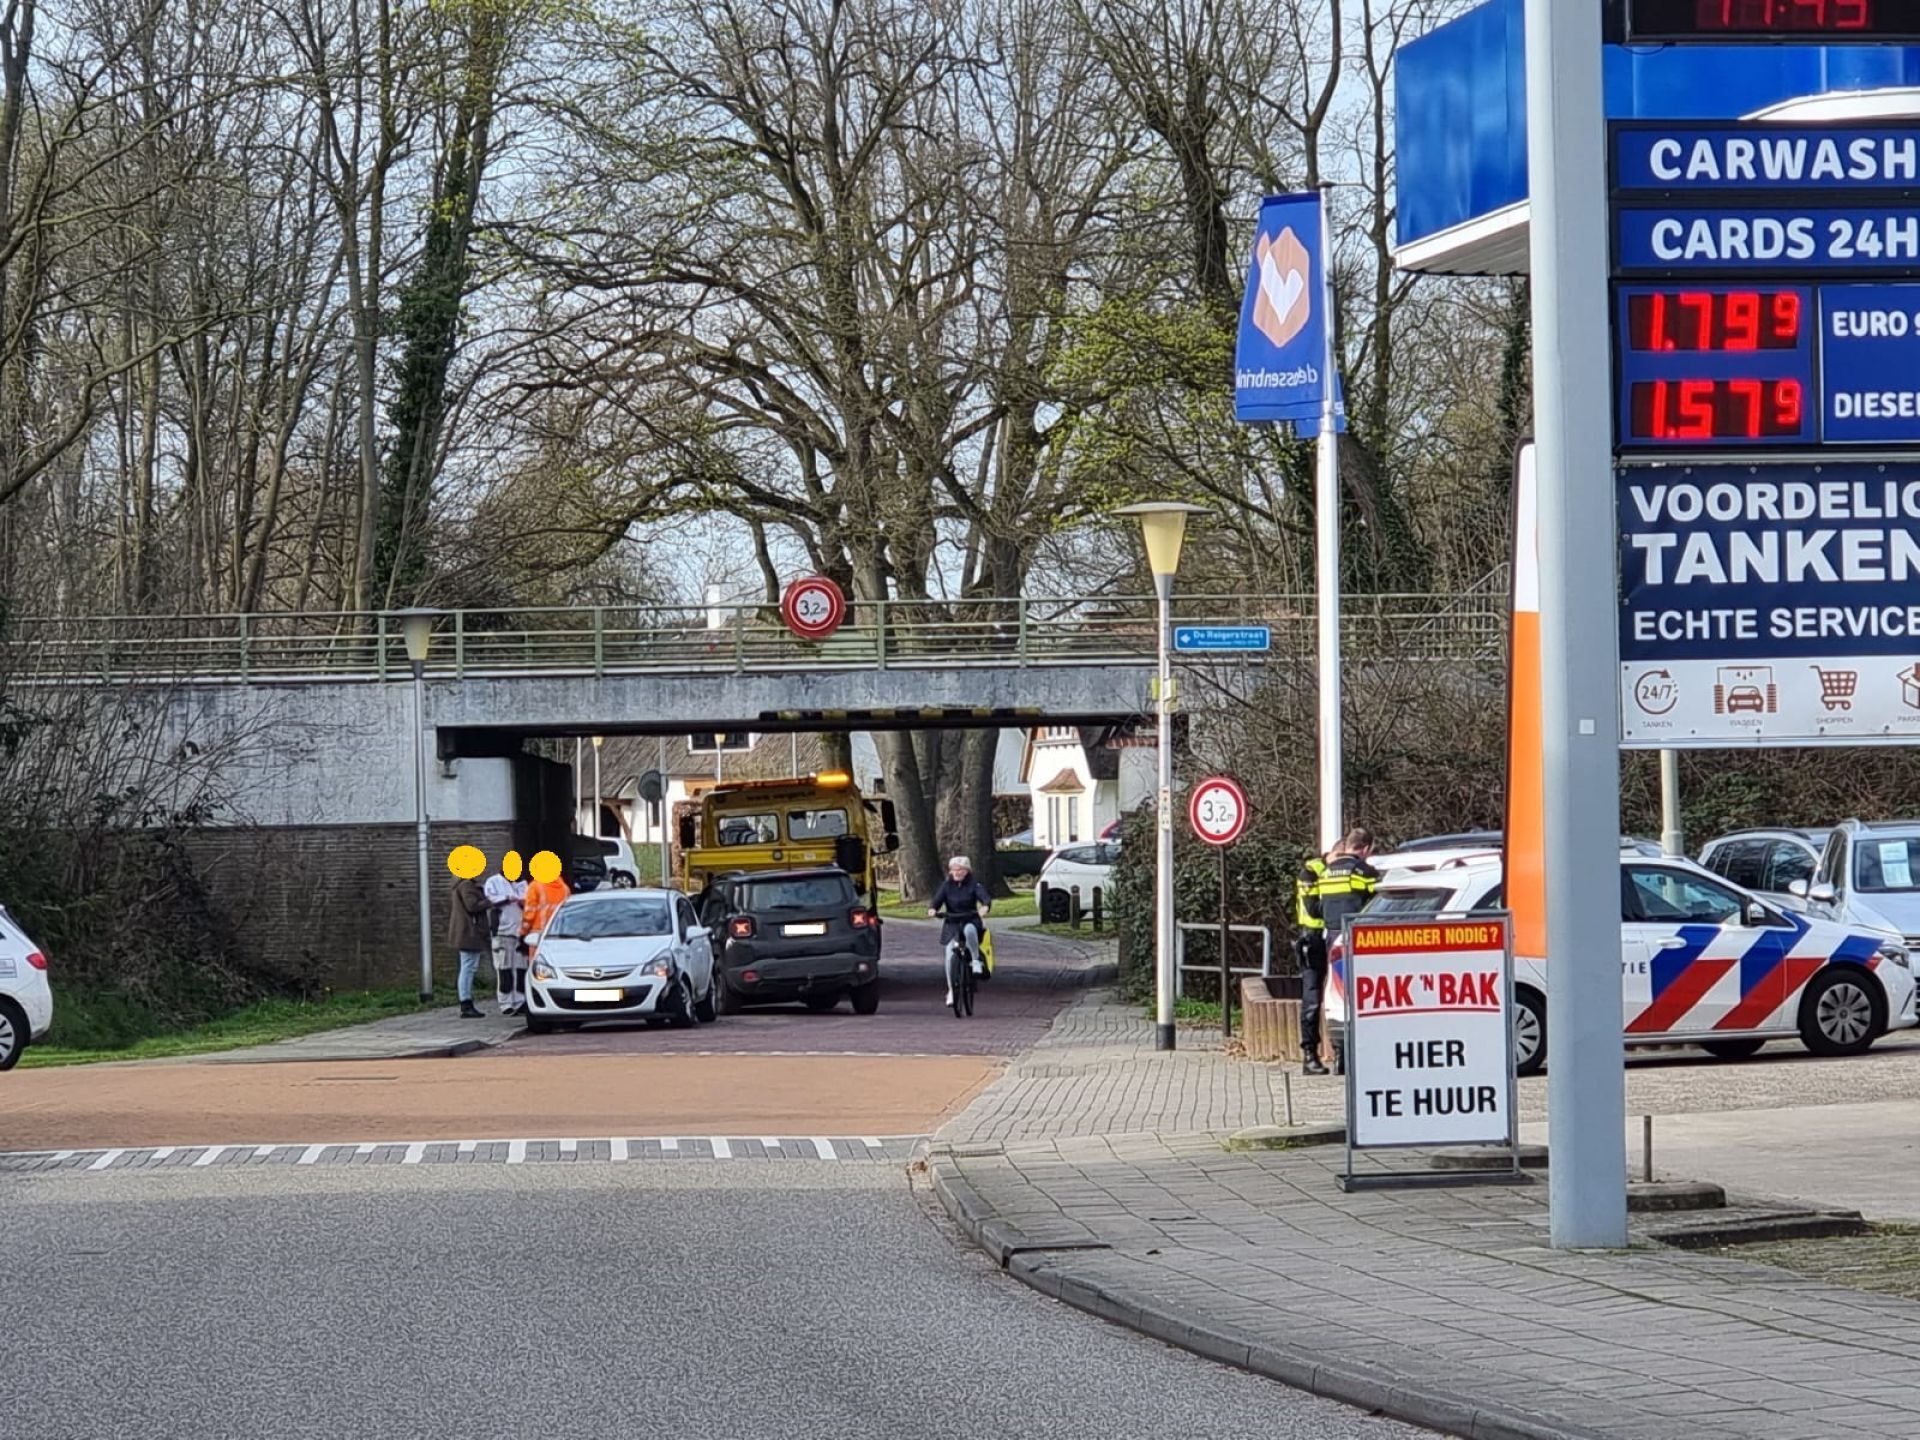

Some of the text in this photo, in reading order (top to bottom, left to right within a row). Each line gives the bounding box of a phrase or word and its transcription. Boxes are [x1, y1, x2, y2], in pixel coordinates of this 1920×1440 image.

[1650, 138, 1917, 180] CARWASH
[1652, 217, 1918, 260] CARDS 24H
[1651, 292, 1800, 351] 1.799
[1833, 311, 1908, 337] EURO
[1652, 379, 1802, 439] 1.579
[1632, 529, 1920, 584] TANKEN
[1193, 630, 1205, 639] De
[1633, 609, 1758, 640] ECHTE
[1641, 684, 1672, 700] 24/7
[1642, 720, 1673, 728] TANKEN
[1355, 928, 1441, 948] AANHANGER
[1446, 927, 1488, 945] NODIG
[1356, 974, 1413, 1010] PAK
[1439, 972, 1499, 1006] BAK
[1395, 1039, 1466, 1069] HIER
[1365, 1085, 1497, 1117] TE HUUR
